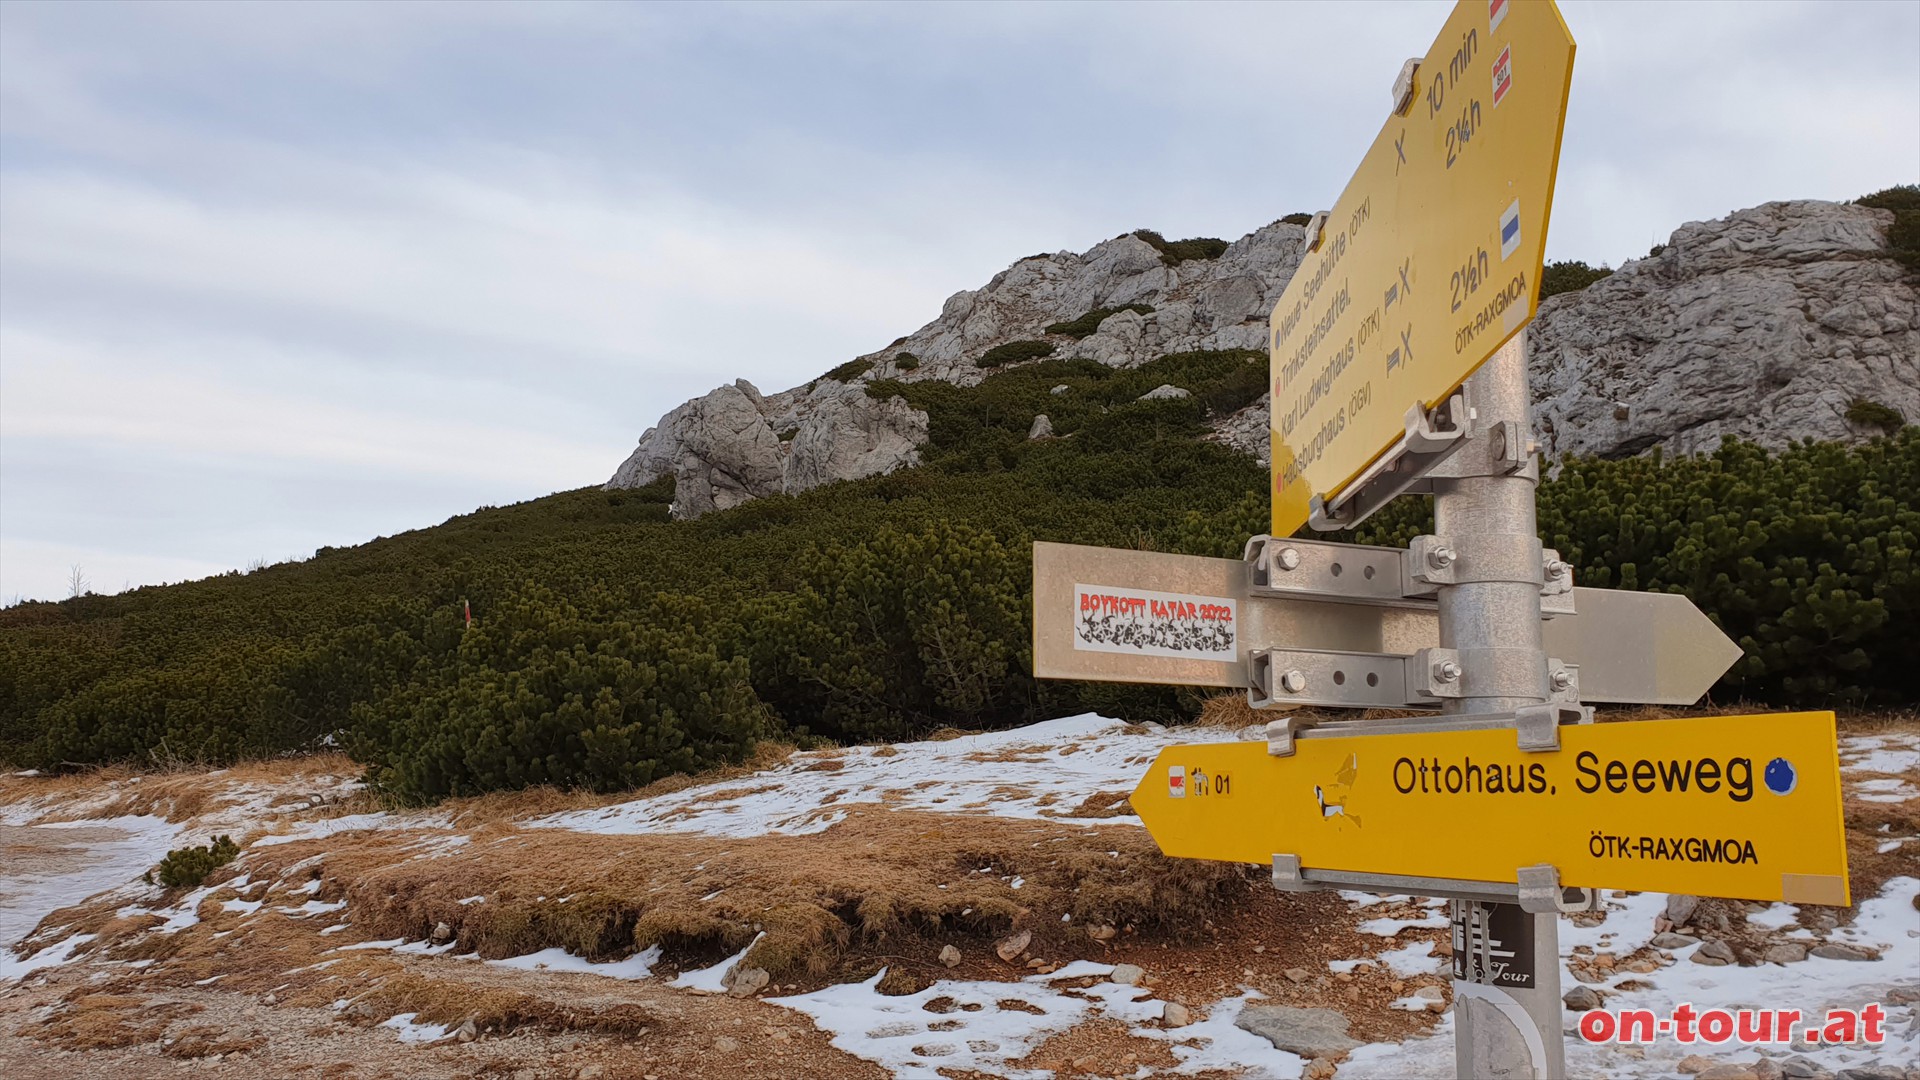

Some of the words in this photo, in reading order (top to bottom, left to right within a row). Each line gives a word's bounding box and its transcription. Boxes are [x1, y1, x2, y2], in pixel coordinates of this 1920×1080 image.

[1427, 72, 1444, 120] 10
[1450, 28, 1477, 90] min
[1281, 299, 1301, 346] Neue
[1303, 231, 1346, 310] Seehütte
[1349, 196, 1371, 245] (ÖTK)
[1455, 271, 1526, 355] ÖTK-RAXGMOA
[1281, 400, 1298, 442] Karl
[1299, 337, 1354, 420] Ludwighaus
[1357, 307, 1380, 354] (ÖTK)
[1282, 407, 1345, 491] Habsburghaus
[1080, 593, 1146, 618] BOYKOTT
[1150, 599, 1198, 622] KATAR
[1199, 603, 1232, 622] 2022
[1215, 774, 1230, 795] 01
[1575, 751, 1754, 801] Seeweg
[1589, 830, 1758, 865] ÖTK-RAXGMOA
